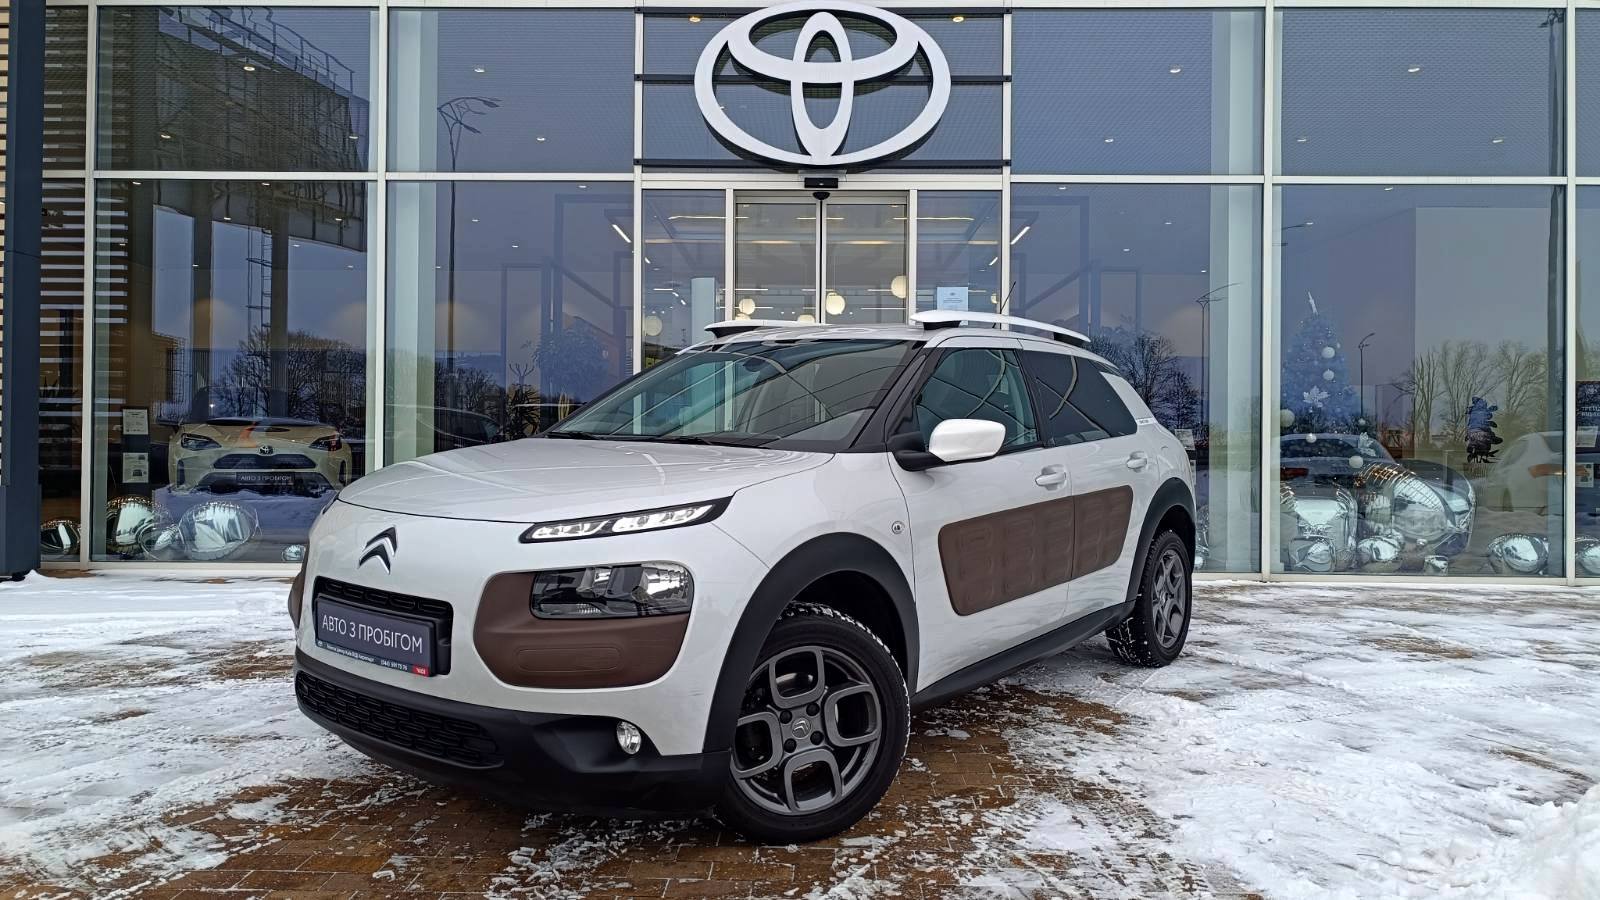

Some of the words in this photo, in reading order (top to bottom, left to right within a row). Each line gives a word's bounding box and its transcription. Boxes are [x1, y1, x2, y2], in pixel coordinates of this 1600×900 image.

[322, 614, 347, 635] АВТО
[349, 622, 356, 638] З
[358, 624, 423, 654] ПРОБІГОМ
